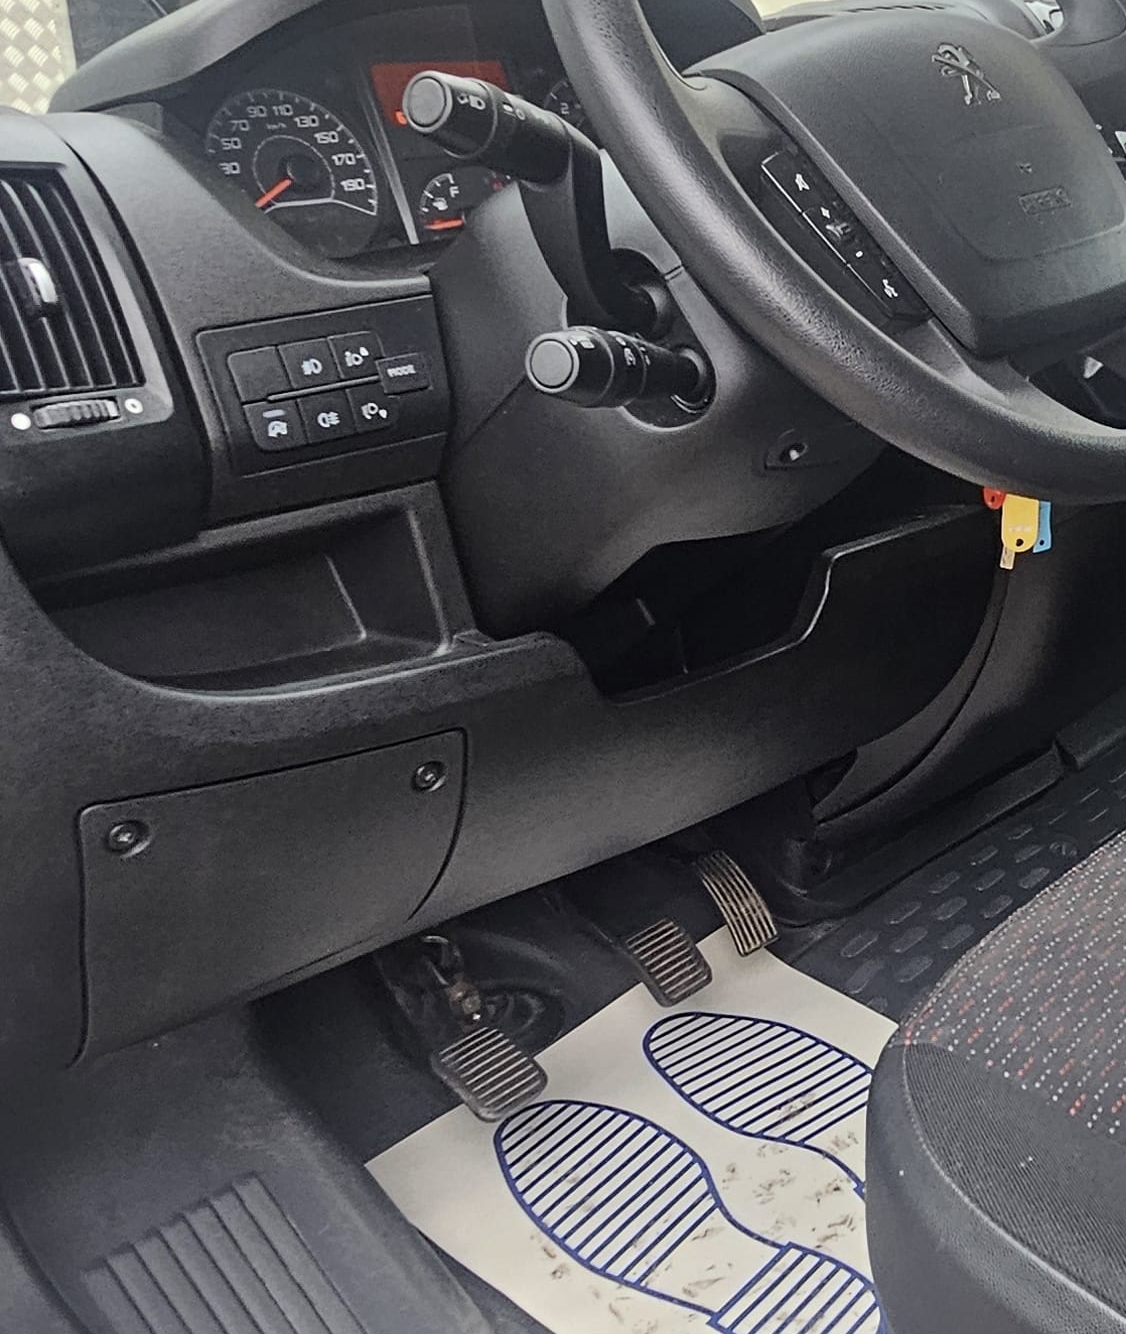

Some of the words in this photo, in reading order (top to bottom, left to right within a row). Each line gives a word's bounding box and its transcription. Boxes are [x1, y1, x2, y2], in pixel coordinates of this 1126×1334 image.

[246, 105, 268, 118] 90
[272, 104, 294, 117] 110
[228, 119, 250, 132] 70
[293, 115, 320, 128] 130
[220, 137, 243, 151] 50
[313, 131, 340, 144] 150
[331, 153, 357, 166] 170
[218, 161, 241, 175] 30
[449, 185, 460, 198] F
[386, 363, 417, 378] MODE
